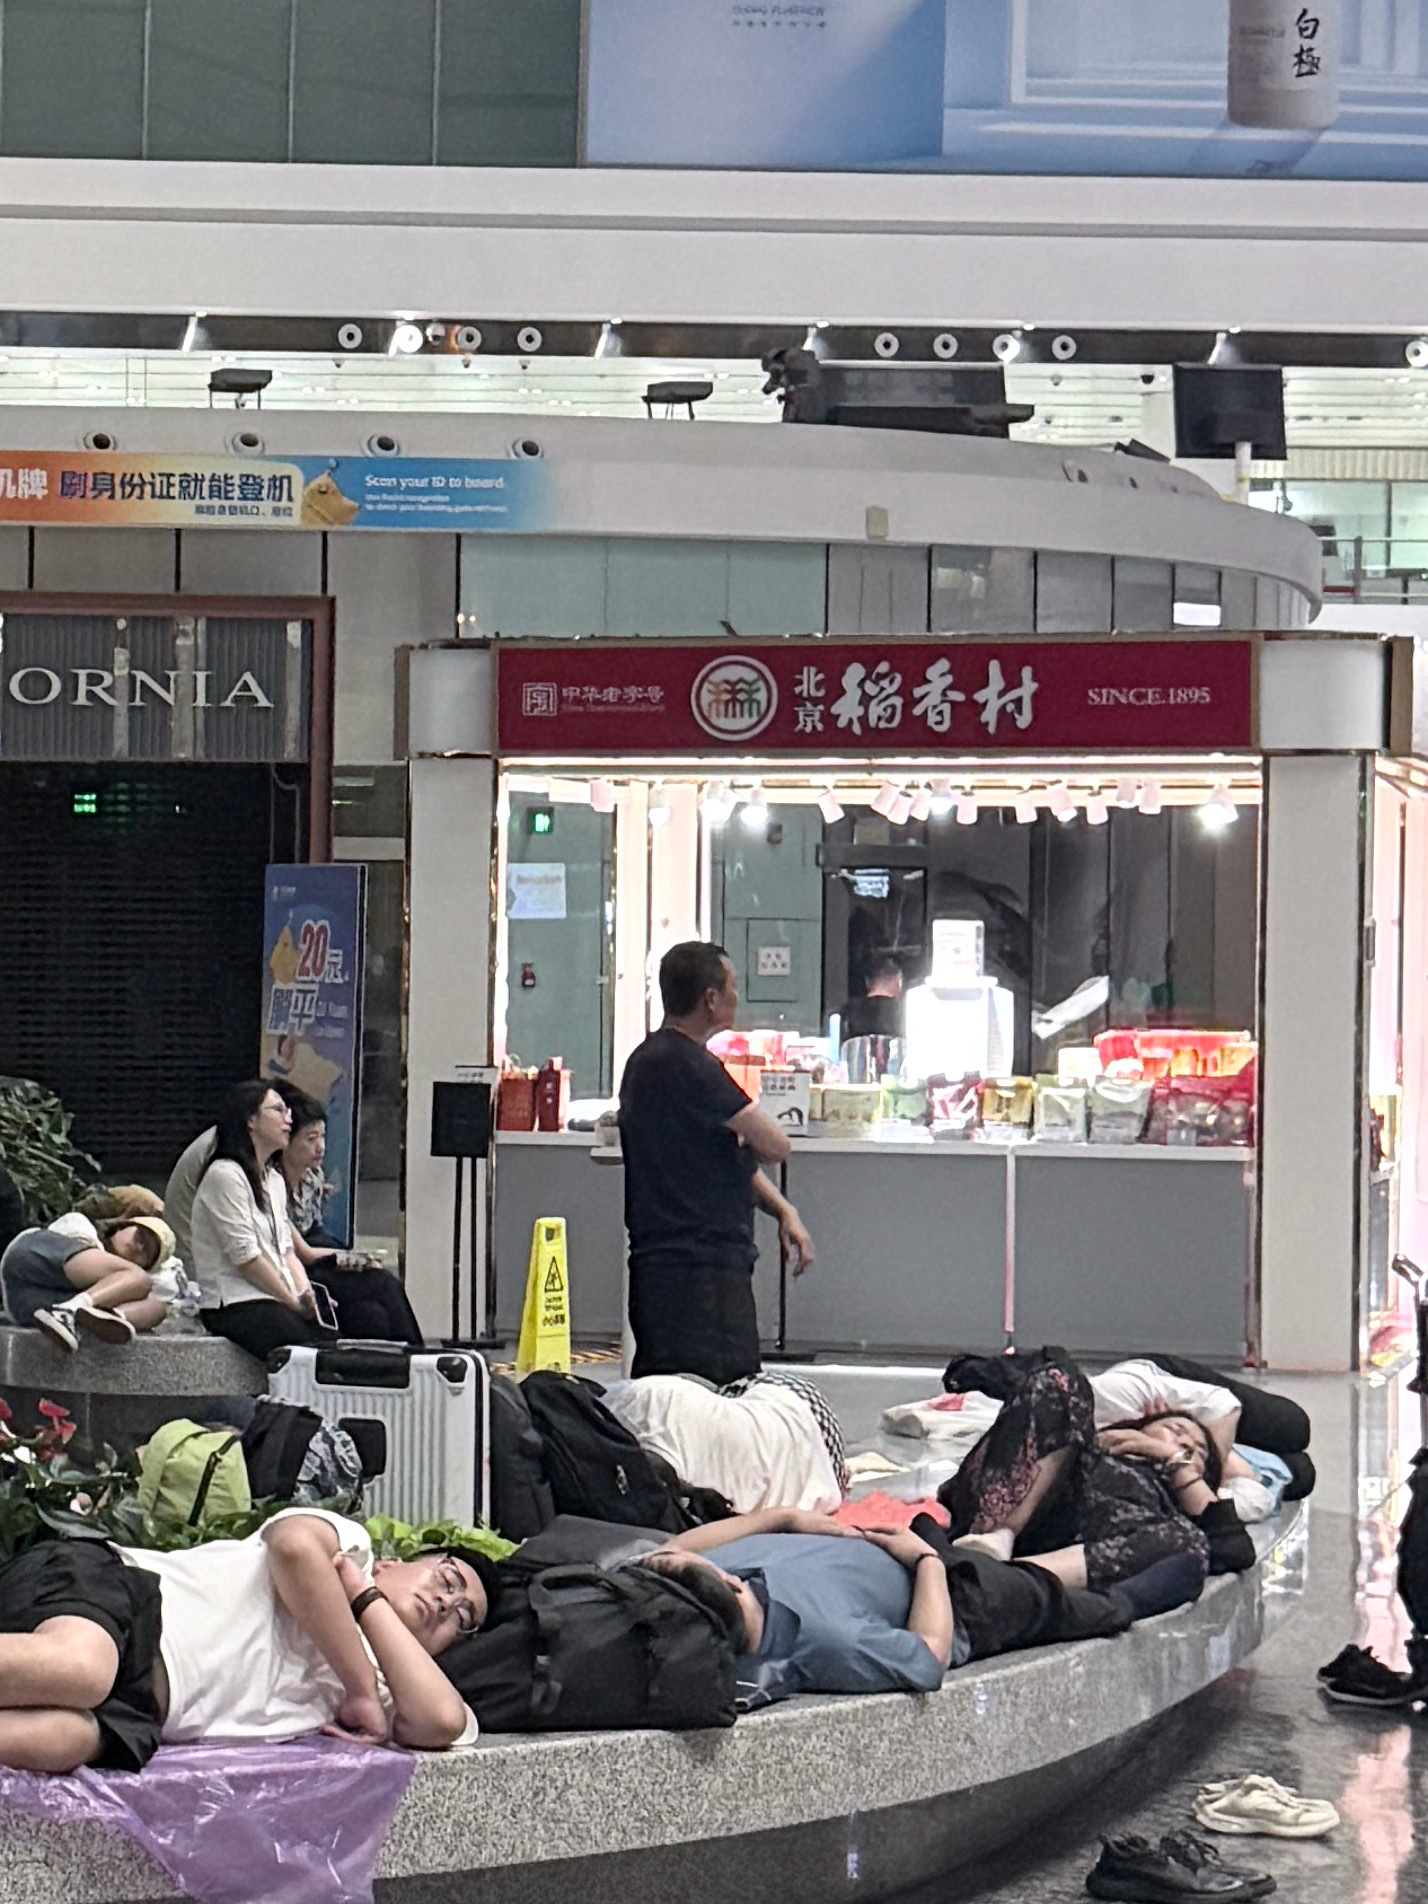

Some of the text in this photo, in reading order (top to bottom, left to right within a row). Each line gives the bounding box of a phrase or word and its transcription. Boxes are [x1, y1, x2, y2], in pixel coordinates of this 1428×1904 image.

[60, 469, 294, 502] 刷身份证就能登机
[364, 474, 397, 487] Scan
[432, 476, 446, 487] ID
[448, 476, 462, 487] to
[793, 657, 1040, 736] 北京 稻香村
